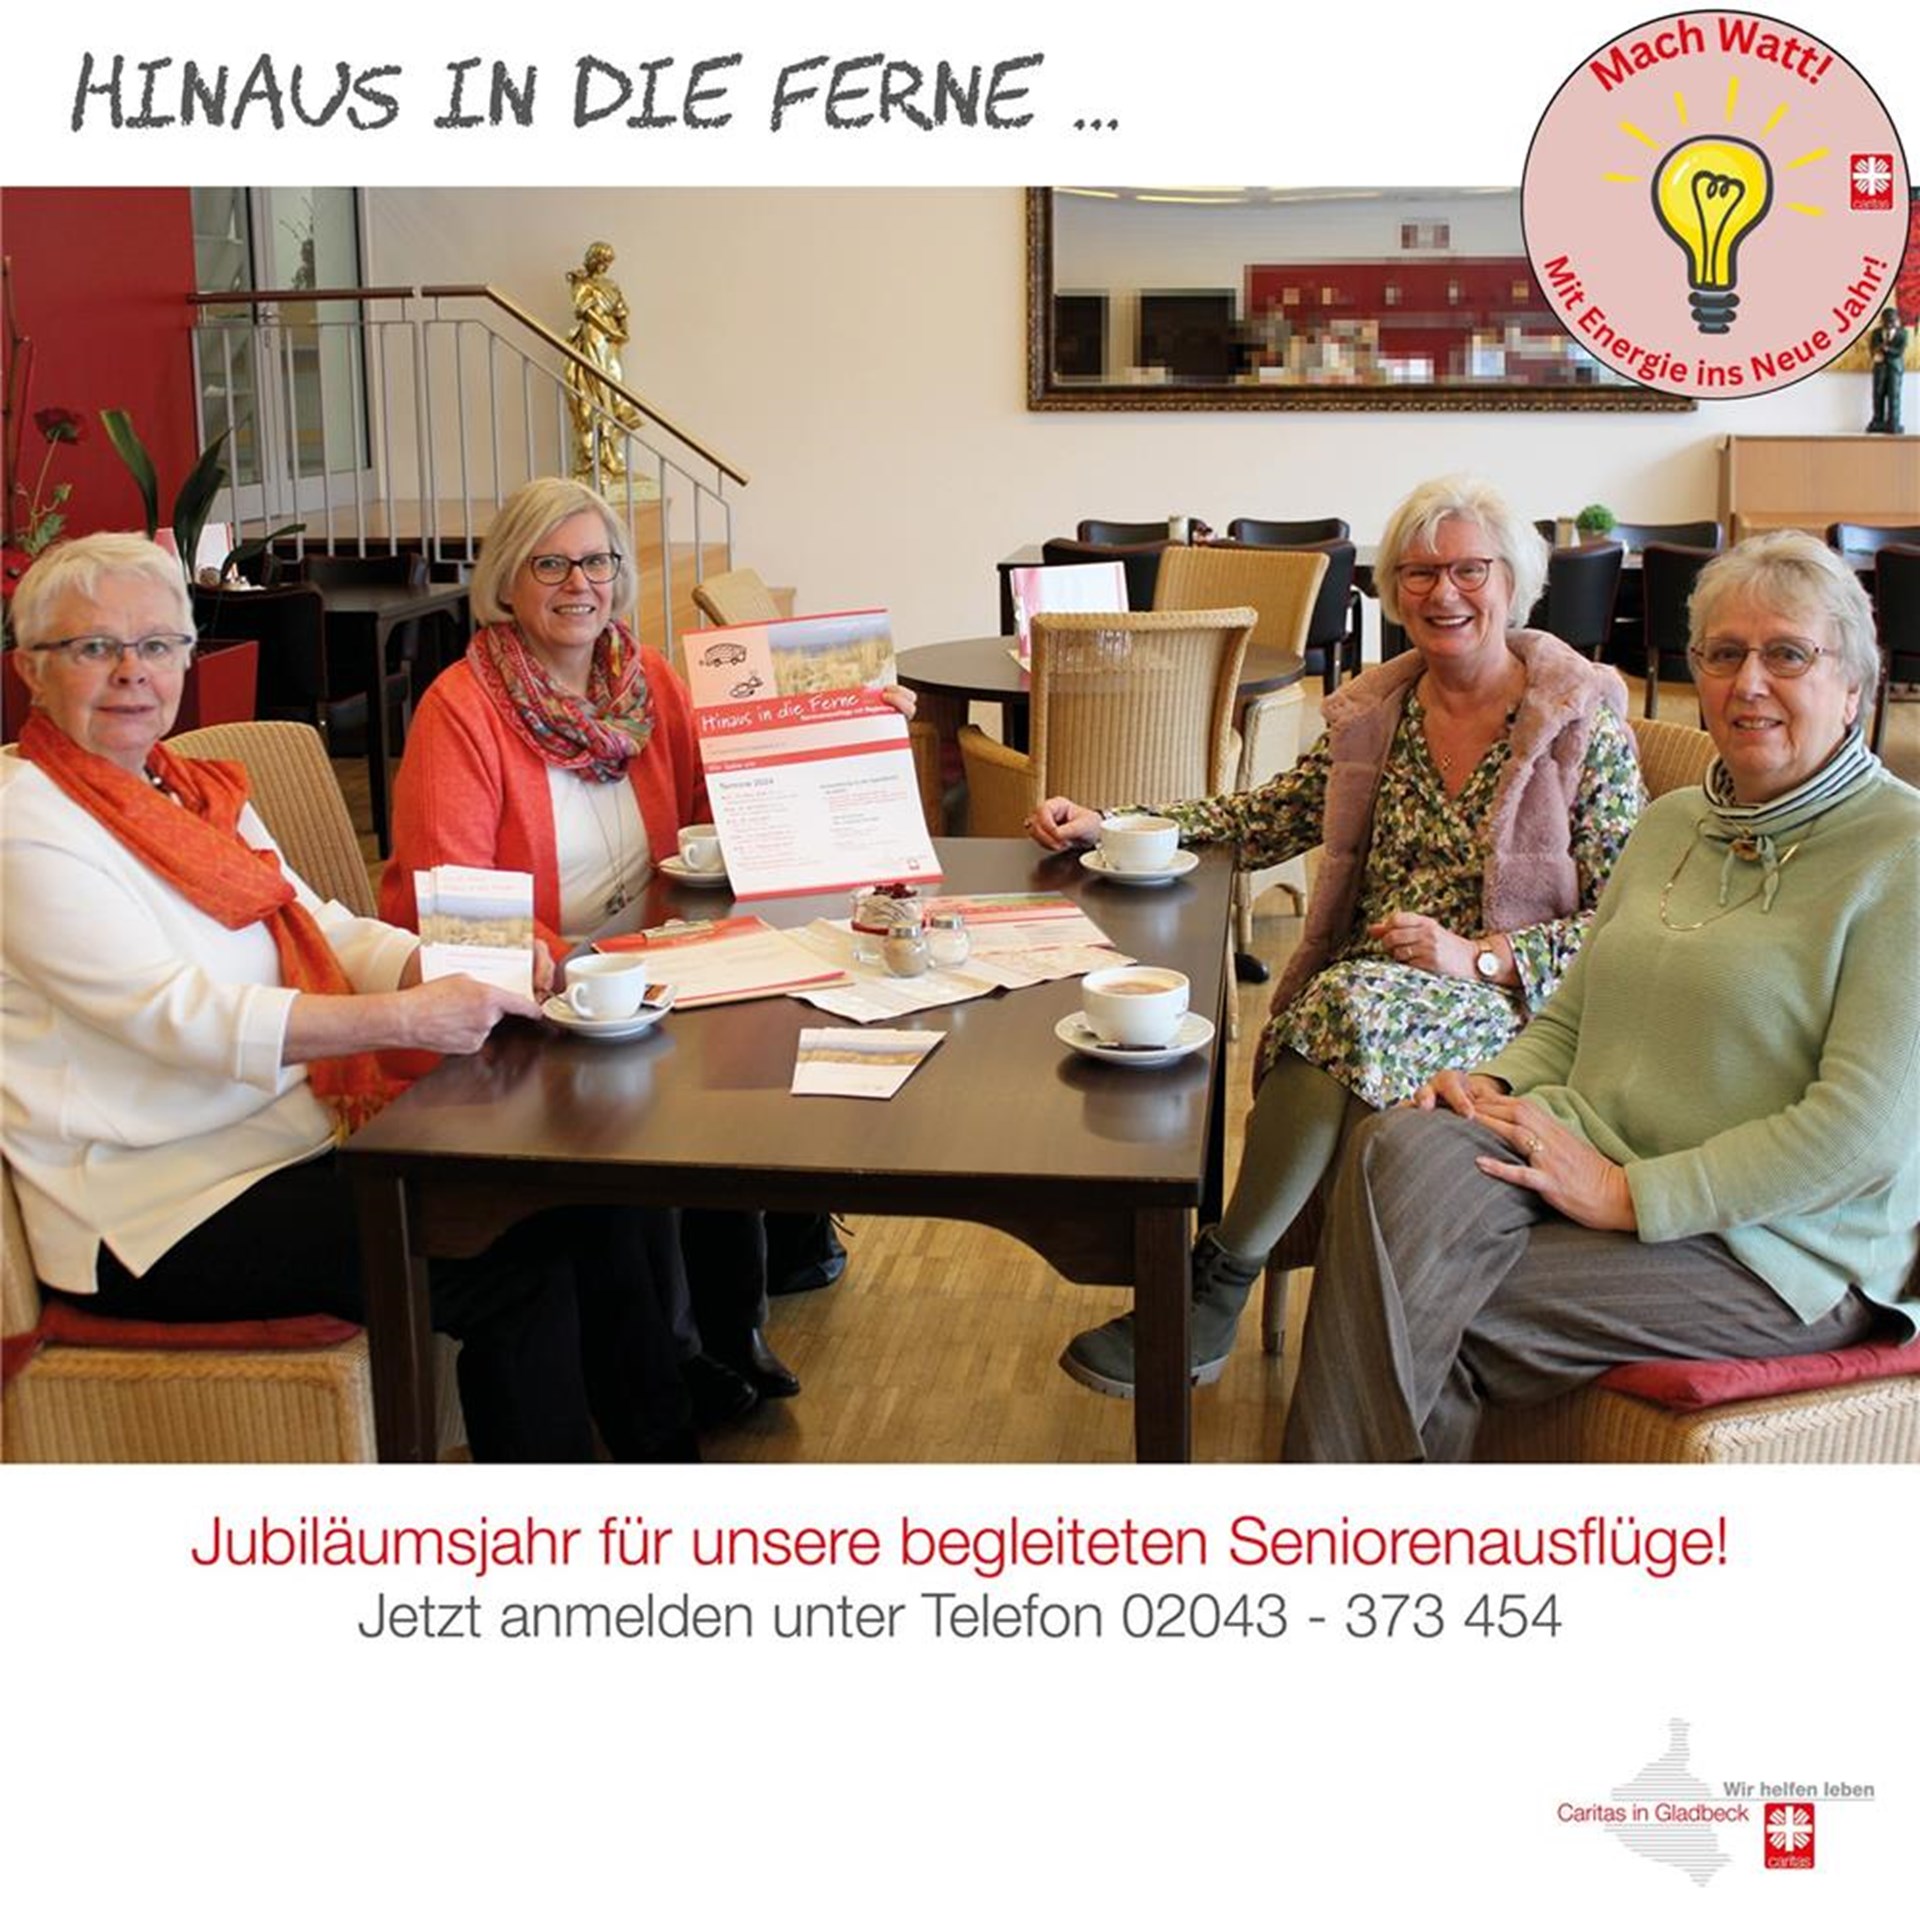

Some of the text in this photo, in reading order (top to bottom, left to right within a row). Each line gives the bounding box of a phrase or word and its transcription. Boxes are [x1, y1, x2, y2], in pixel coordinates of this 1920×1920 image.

[701, 711, 752, 731] Hinaus
[758, 706, 772, 721] in
[778, 700, 804, 718] die
[808, 693, 858, 713] Ferne
